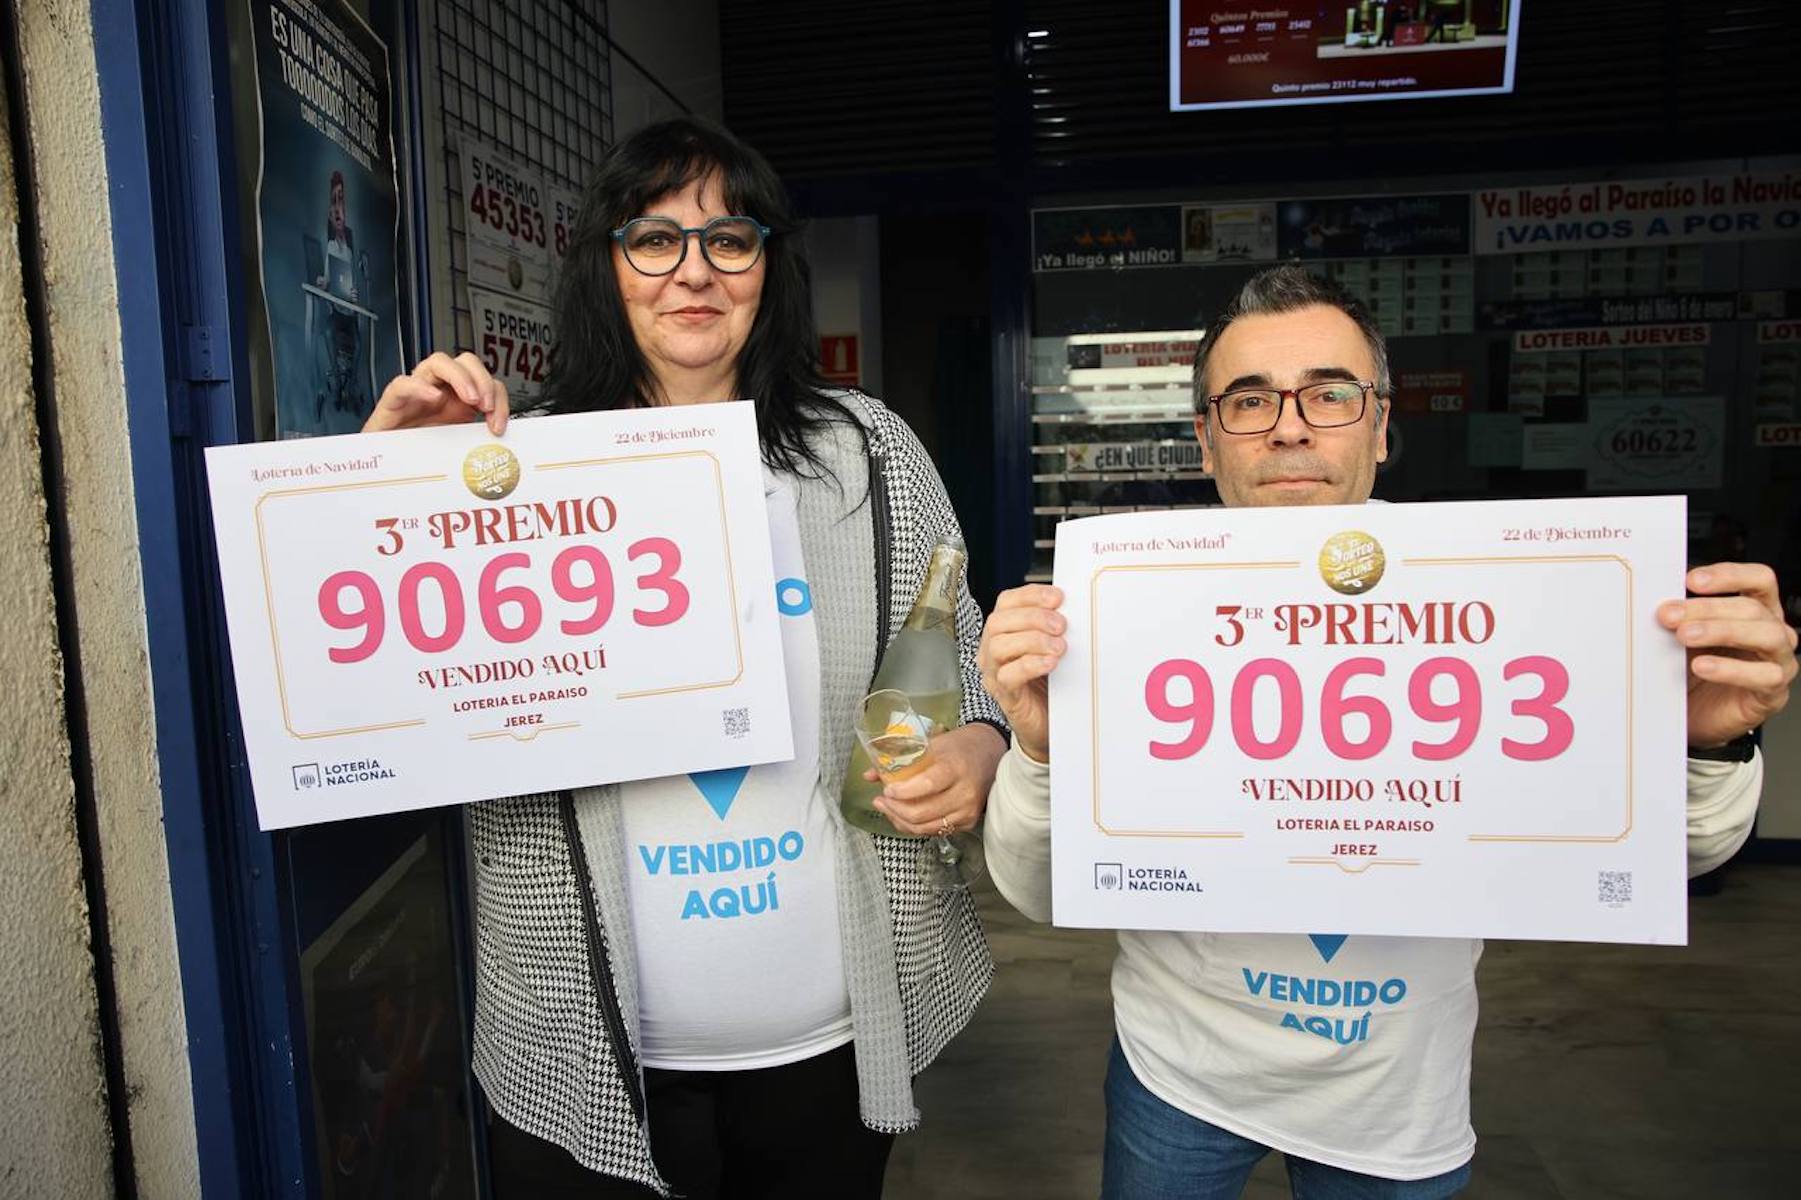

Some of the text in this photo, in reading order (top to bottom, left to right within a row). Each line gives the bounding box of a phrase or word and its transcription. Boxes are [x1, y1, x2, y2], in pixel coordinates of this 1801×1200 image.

[270, 5, 288, 47] ES
[290, 20, 315, 70] UNA
[315, 43, 344, 93] COSA
[485, 162, 539, 207] PREMIO
[1481, 192, 1511, 218] Ya
[1519, 187, 1572, 219] llegó
[1580, 186, 1600, 213] al
[1608, 182, 1696, 212] Paraíso
[1704, 178, 1725, 205] la
[471, 183, 546, 248] 45353
[1647, 217, 1670, 236] A
[1683, 211, 1761, 235] POR
[1128, 247, 1176, 265] NIÑO!
[499, 312, 552, 345] PREMIO
[1520, 326, 1706, 350] LOTERIA JUEVES
[484, 333, 554, 382] 5742
[615, 426, 716, 445] 22 de Diciembre
[1611, 427, 1698, 453] 60622
[1158, 443, 1204, 466] CIUDA
[306, 461, 322, 475] de
[429, 496, 617, 549] PREMIO
[1502, 525, 1631, 542] 22 de Diciembre
[1147, 537, 1163, 550] de
[317, 536, 690, 664] 90693
[1274, 601, 1495, 645] PREMIO
[418, 644, 608, 689] VENDIDO AQUÍ
[454, 687, 588, 712] LOTERIA EL PARAISO
[1145, 656, 1575, 761] 90693
[504, 714, 544, 728] JEREZ
[325, 759, 380, 775] LOTERÍA
[327, 768, 396, 786] NACIONAL
[1242, 773, 1462, 808] VENDIDO AQUÍ
[1277, 818, 1435, 833] LOTERIA EL PARAISO
[638, 831, 804, 875] VENDIDO
[1331, 843, 1378, 856] JEREZ
[1128, 866, 1188, 880] LOTERÍA
[681, 871, 779, 919] AQUÍ
[1128, 880, 1204, 893] NACIONAL
[1241, 967, 1408, 1007] VENDIDO
[1280, 1010, 1373, 1046] AQUÍ
